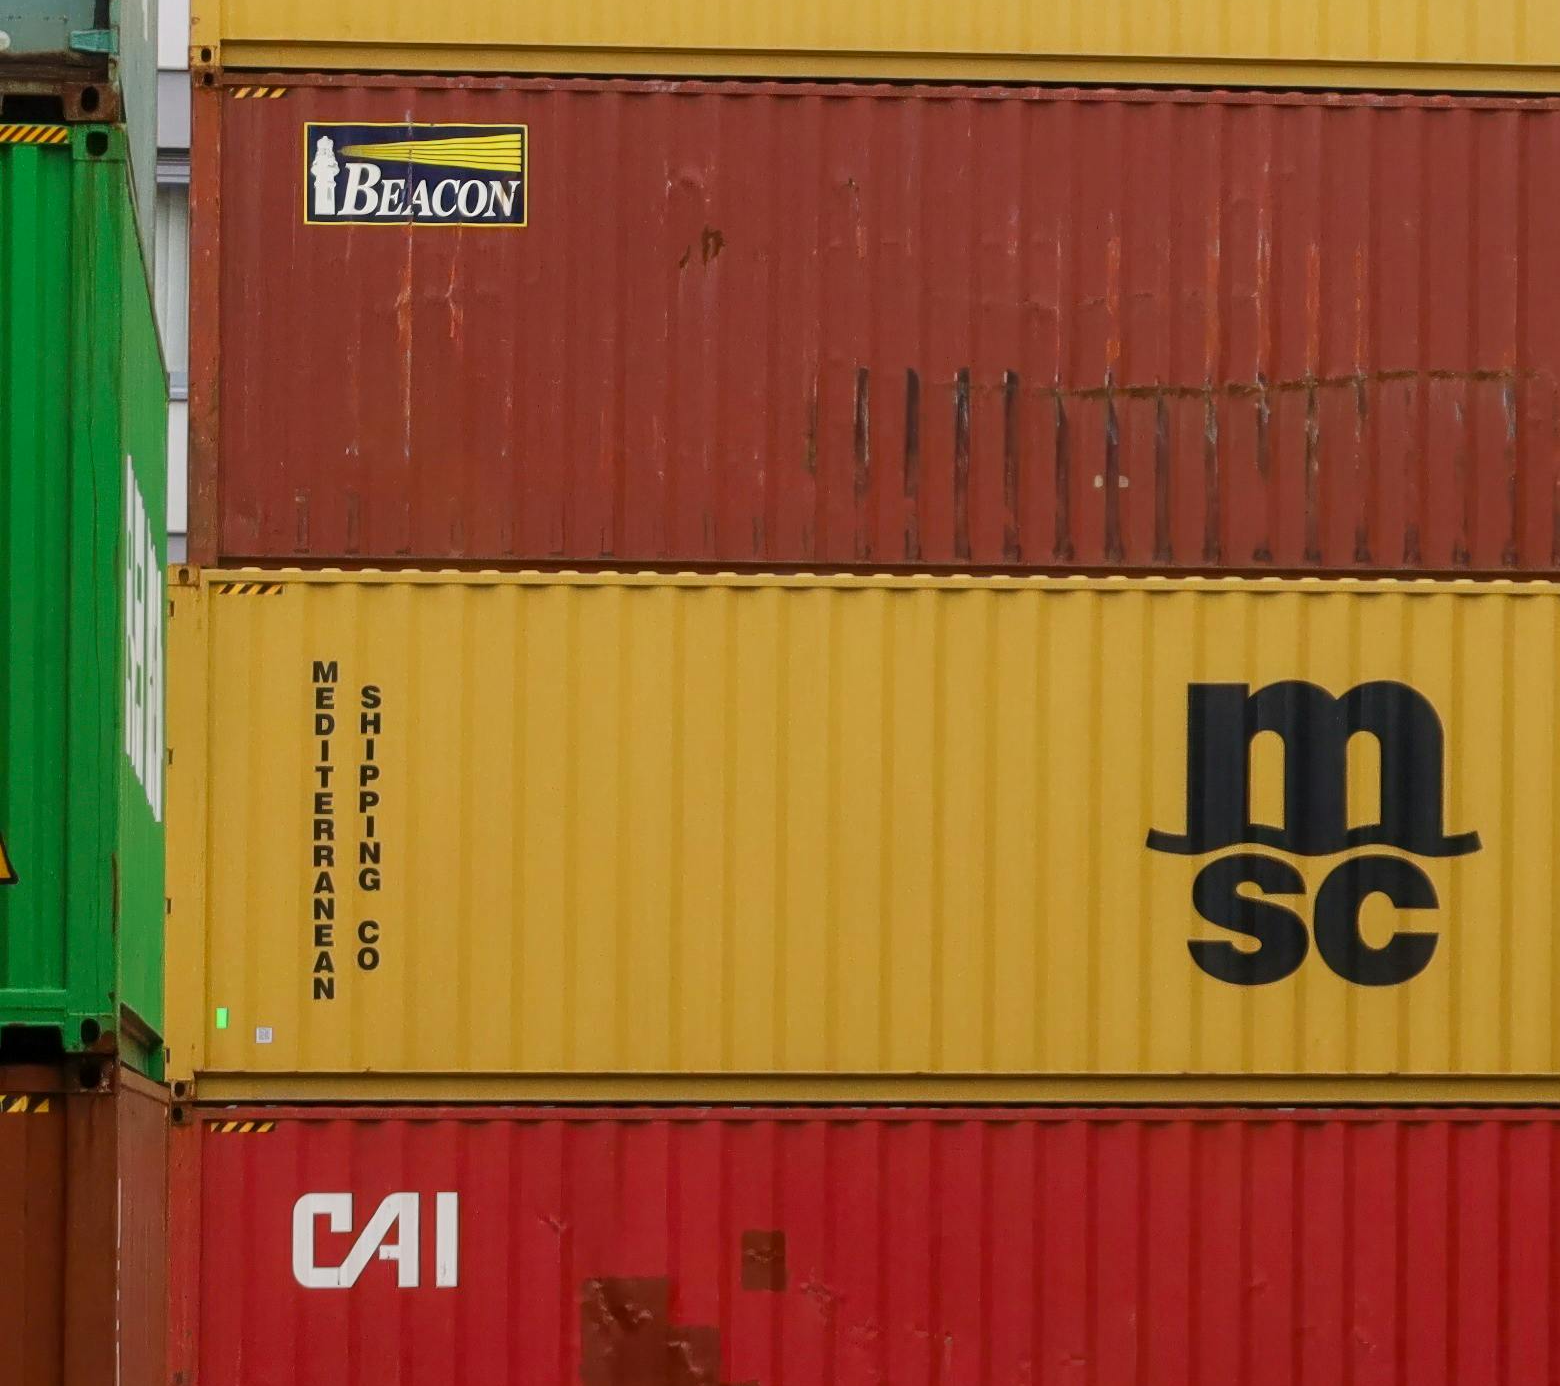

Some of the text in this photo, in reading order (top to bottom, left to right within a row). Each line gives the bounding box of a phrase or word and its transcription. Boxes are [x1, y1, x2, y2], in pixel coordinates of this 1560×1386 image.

[338, 160, 521, 220] BEACON
[312, 661, 338, 1001] MEDITERRANEAN
[356, 685, 382, 972] SHIPPING CO
[291, 1191, 459, 1289] CAI
